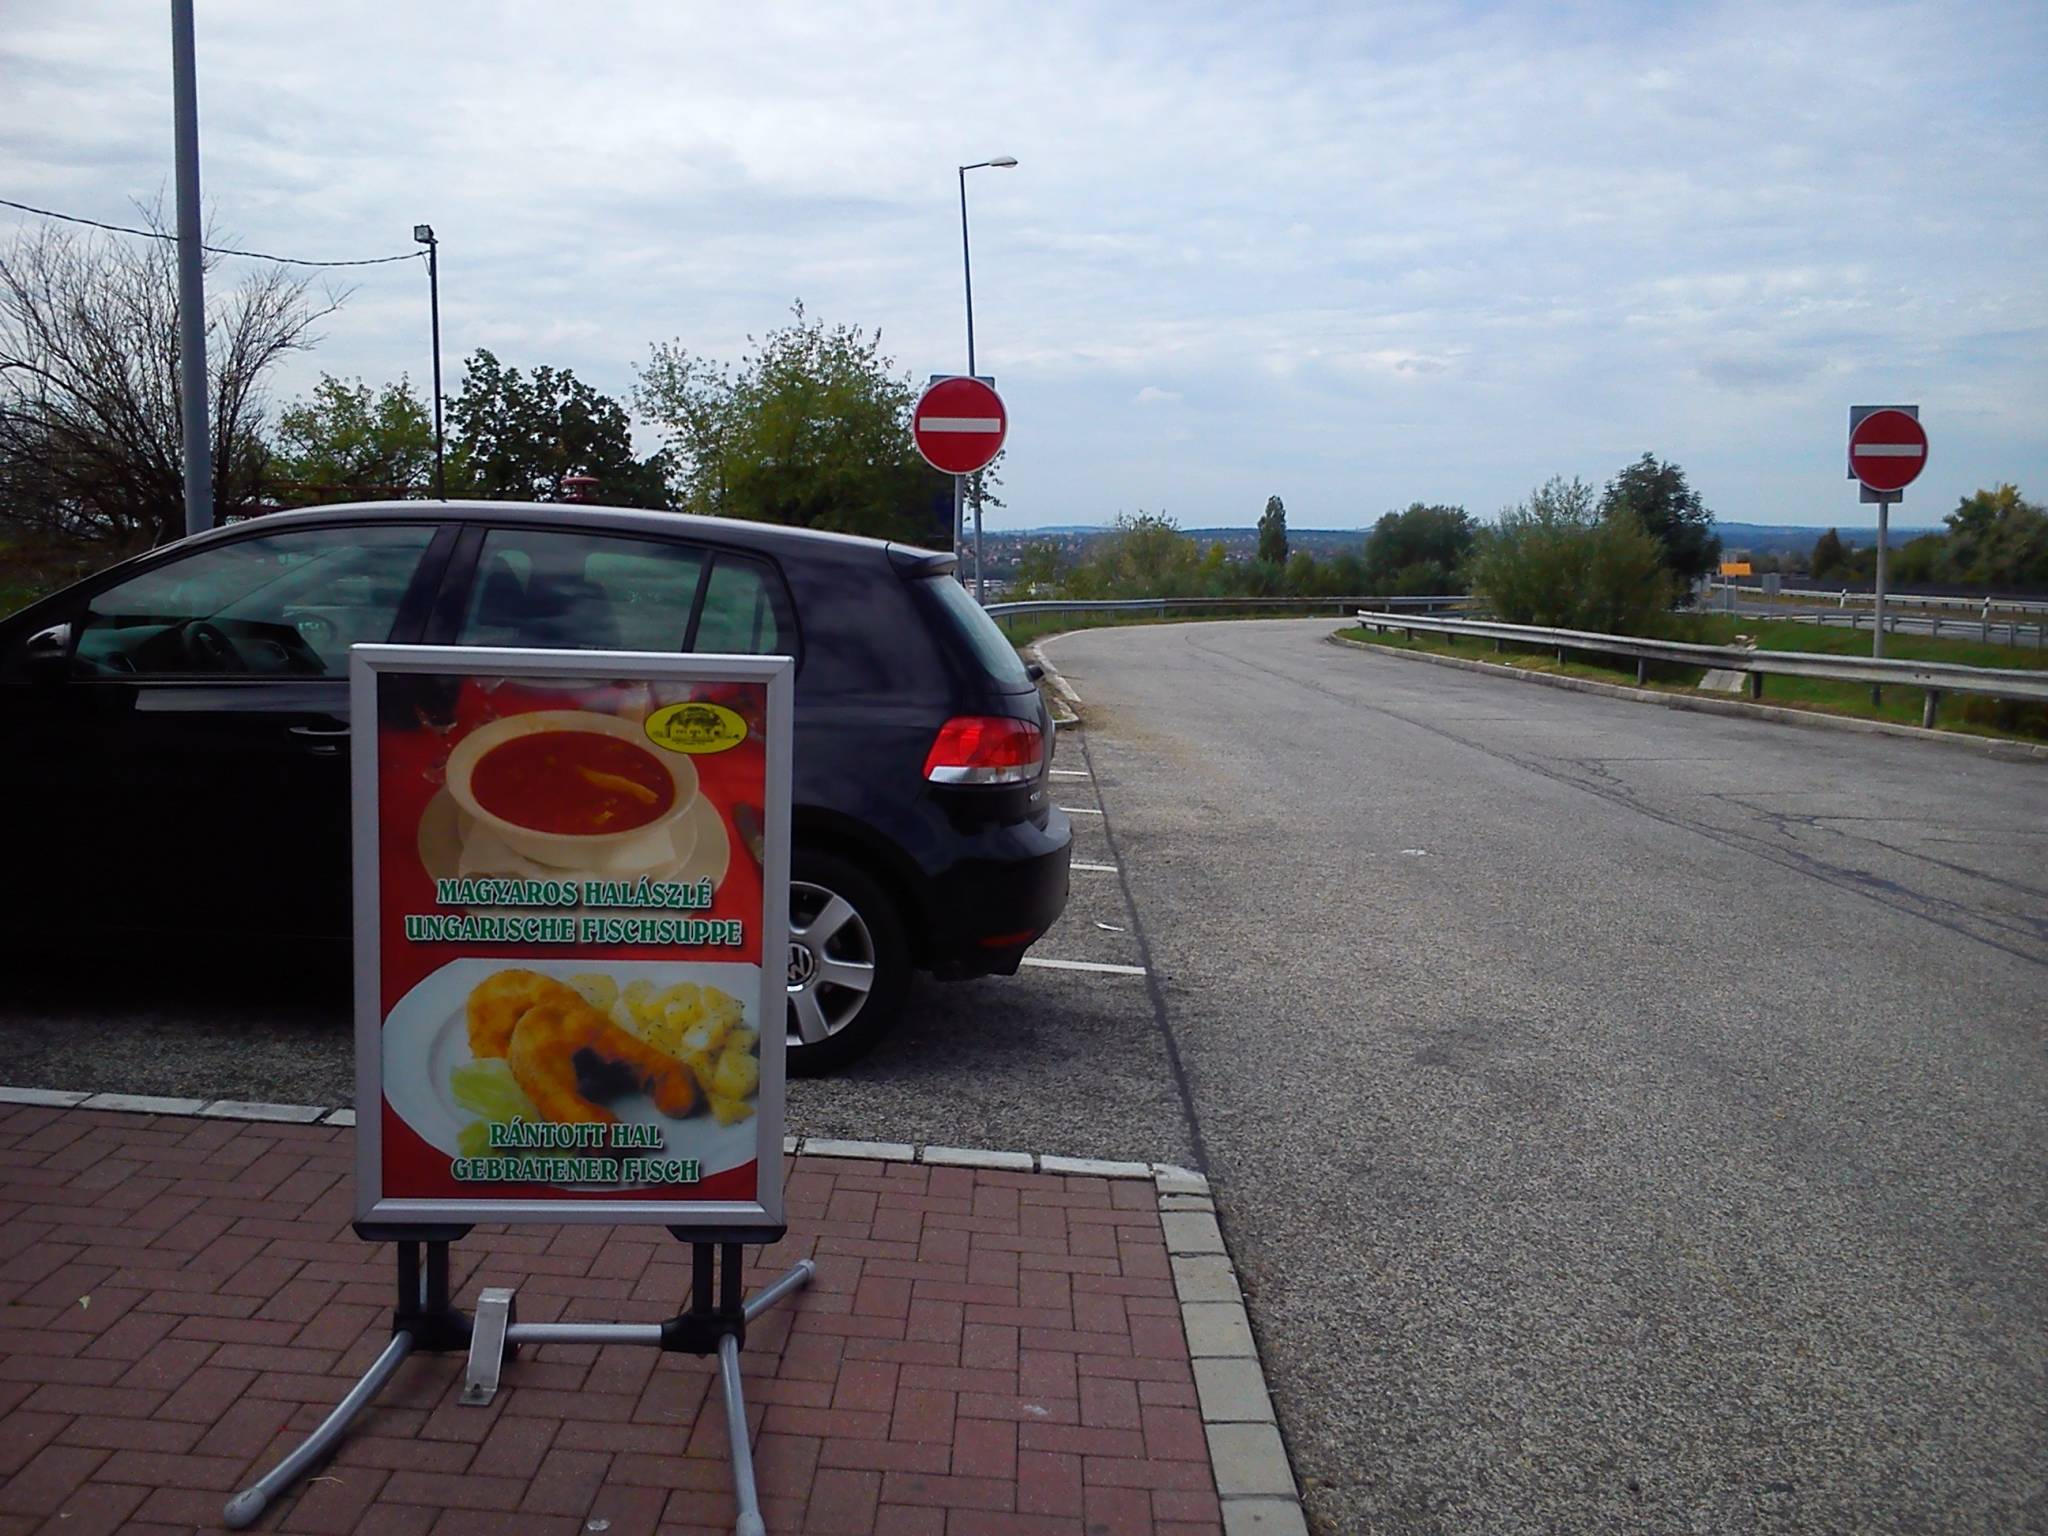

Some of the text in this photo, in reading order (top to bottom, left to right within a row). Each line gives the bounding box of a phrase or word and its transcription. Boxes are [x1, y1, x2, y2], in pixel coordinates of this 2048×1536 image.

[437, 876, 711, 908] MAGYAROS HALÁSZLÉ
[405, 915, 742, 945] UNGARISCHE FISCHSUPPE
[490, 1115, 663, 1149] RÁNTOTT HAL
[452, 1158, 700, 1183] GEBRATENER FISCH
